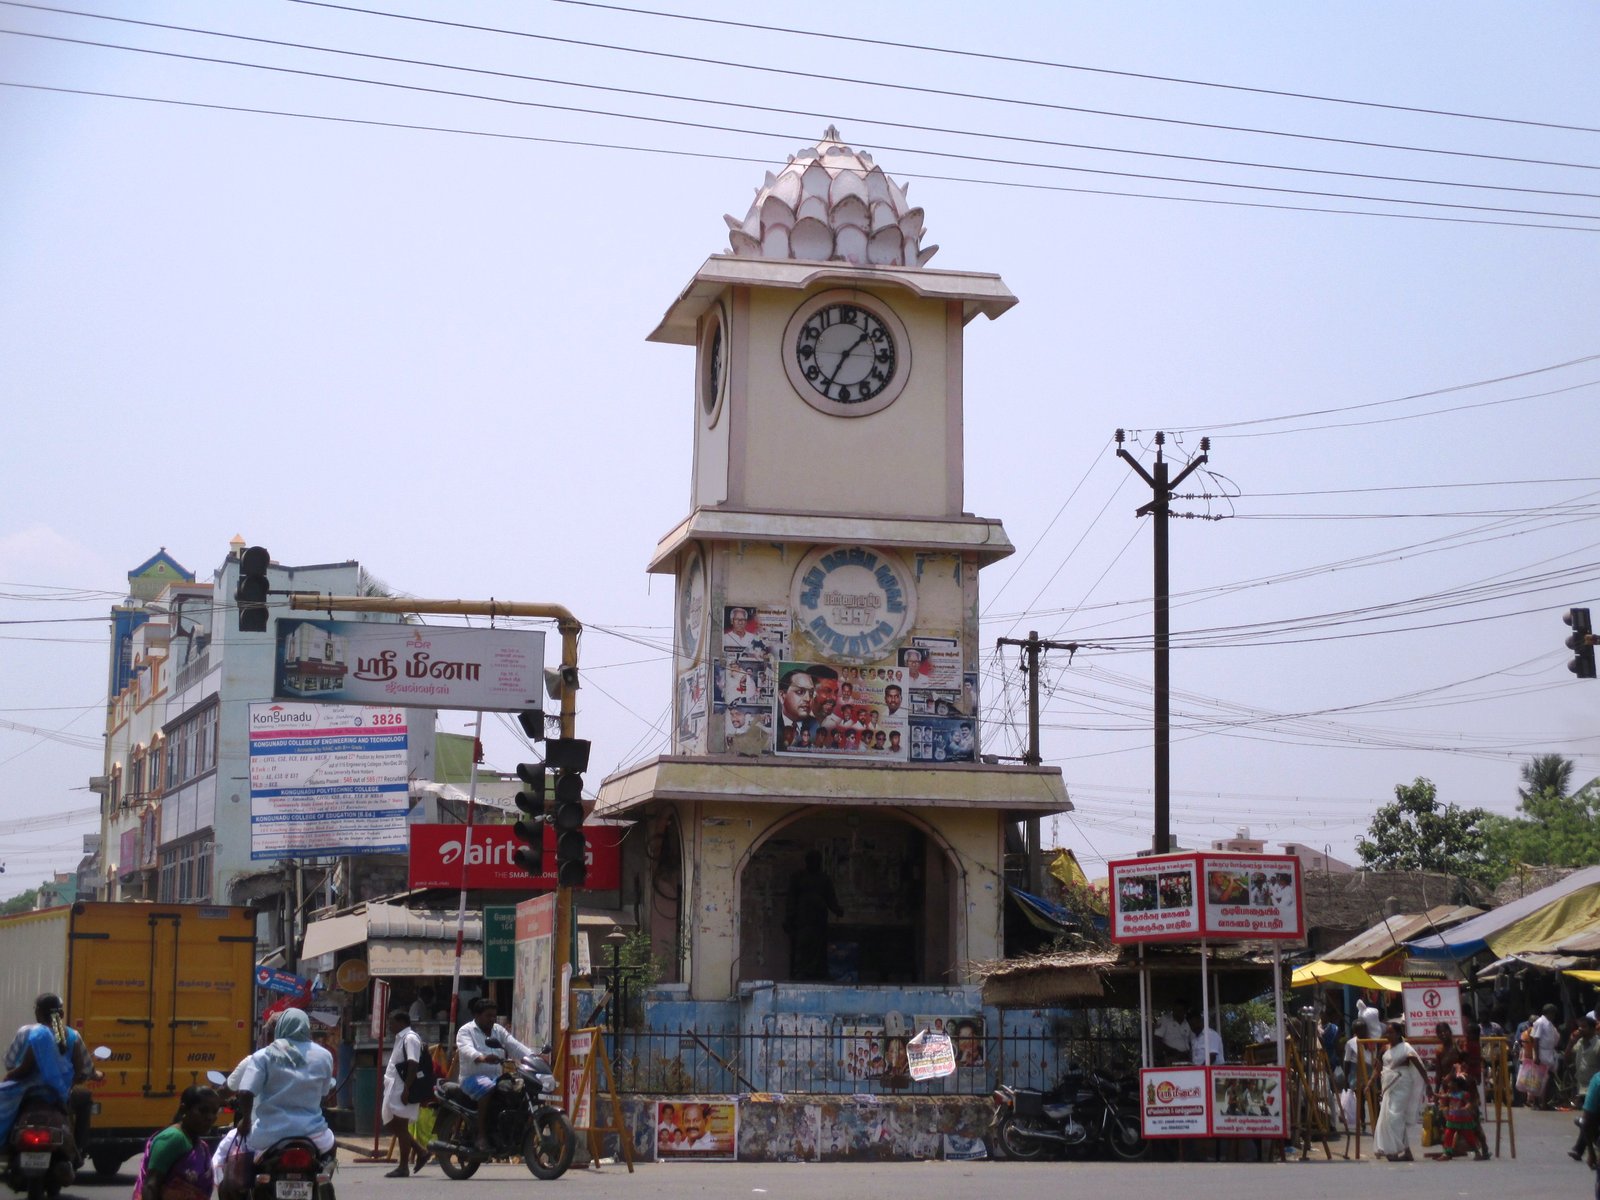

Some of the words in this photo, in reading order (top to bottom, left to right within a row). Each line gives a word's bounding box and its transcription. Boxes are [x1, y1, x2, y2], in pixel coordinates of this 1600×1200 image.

[871, 328, 884, 342] 2
[875, 348, 888, 364] 3
[406, 641, 431, 649] PDR
[405, 652, 482, 681] மீனா
[253, 711, 312, 724] Kongunadu
[372, 712, 402, 726] 3826
[322, 737, 357, 745] ENGINEERING
[370, 735, 405, 743] TECHNOLOGY
[316, 786, 353, 794] POLYTECHNIC
[347, 968, 367, 981] Jio
[1410, 1010, 1423, 1018] NO
[1426, 1009, 1456, 1017] ENTRY
[187, 1052, 216, 1062] HORN
